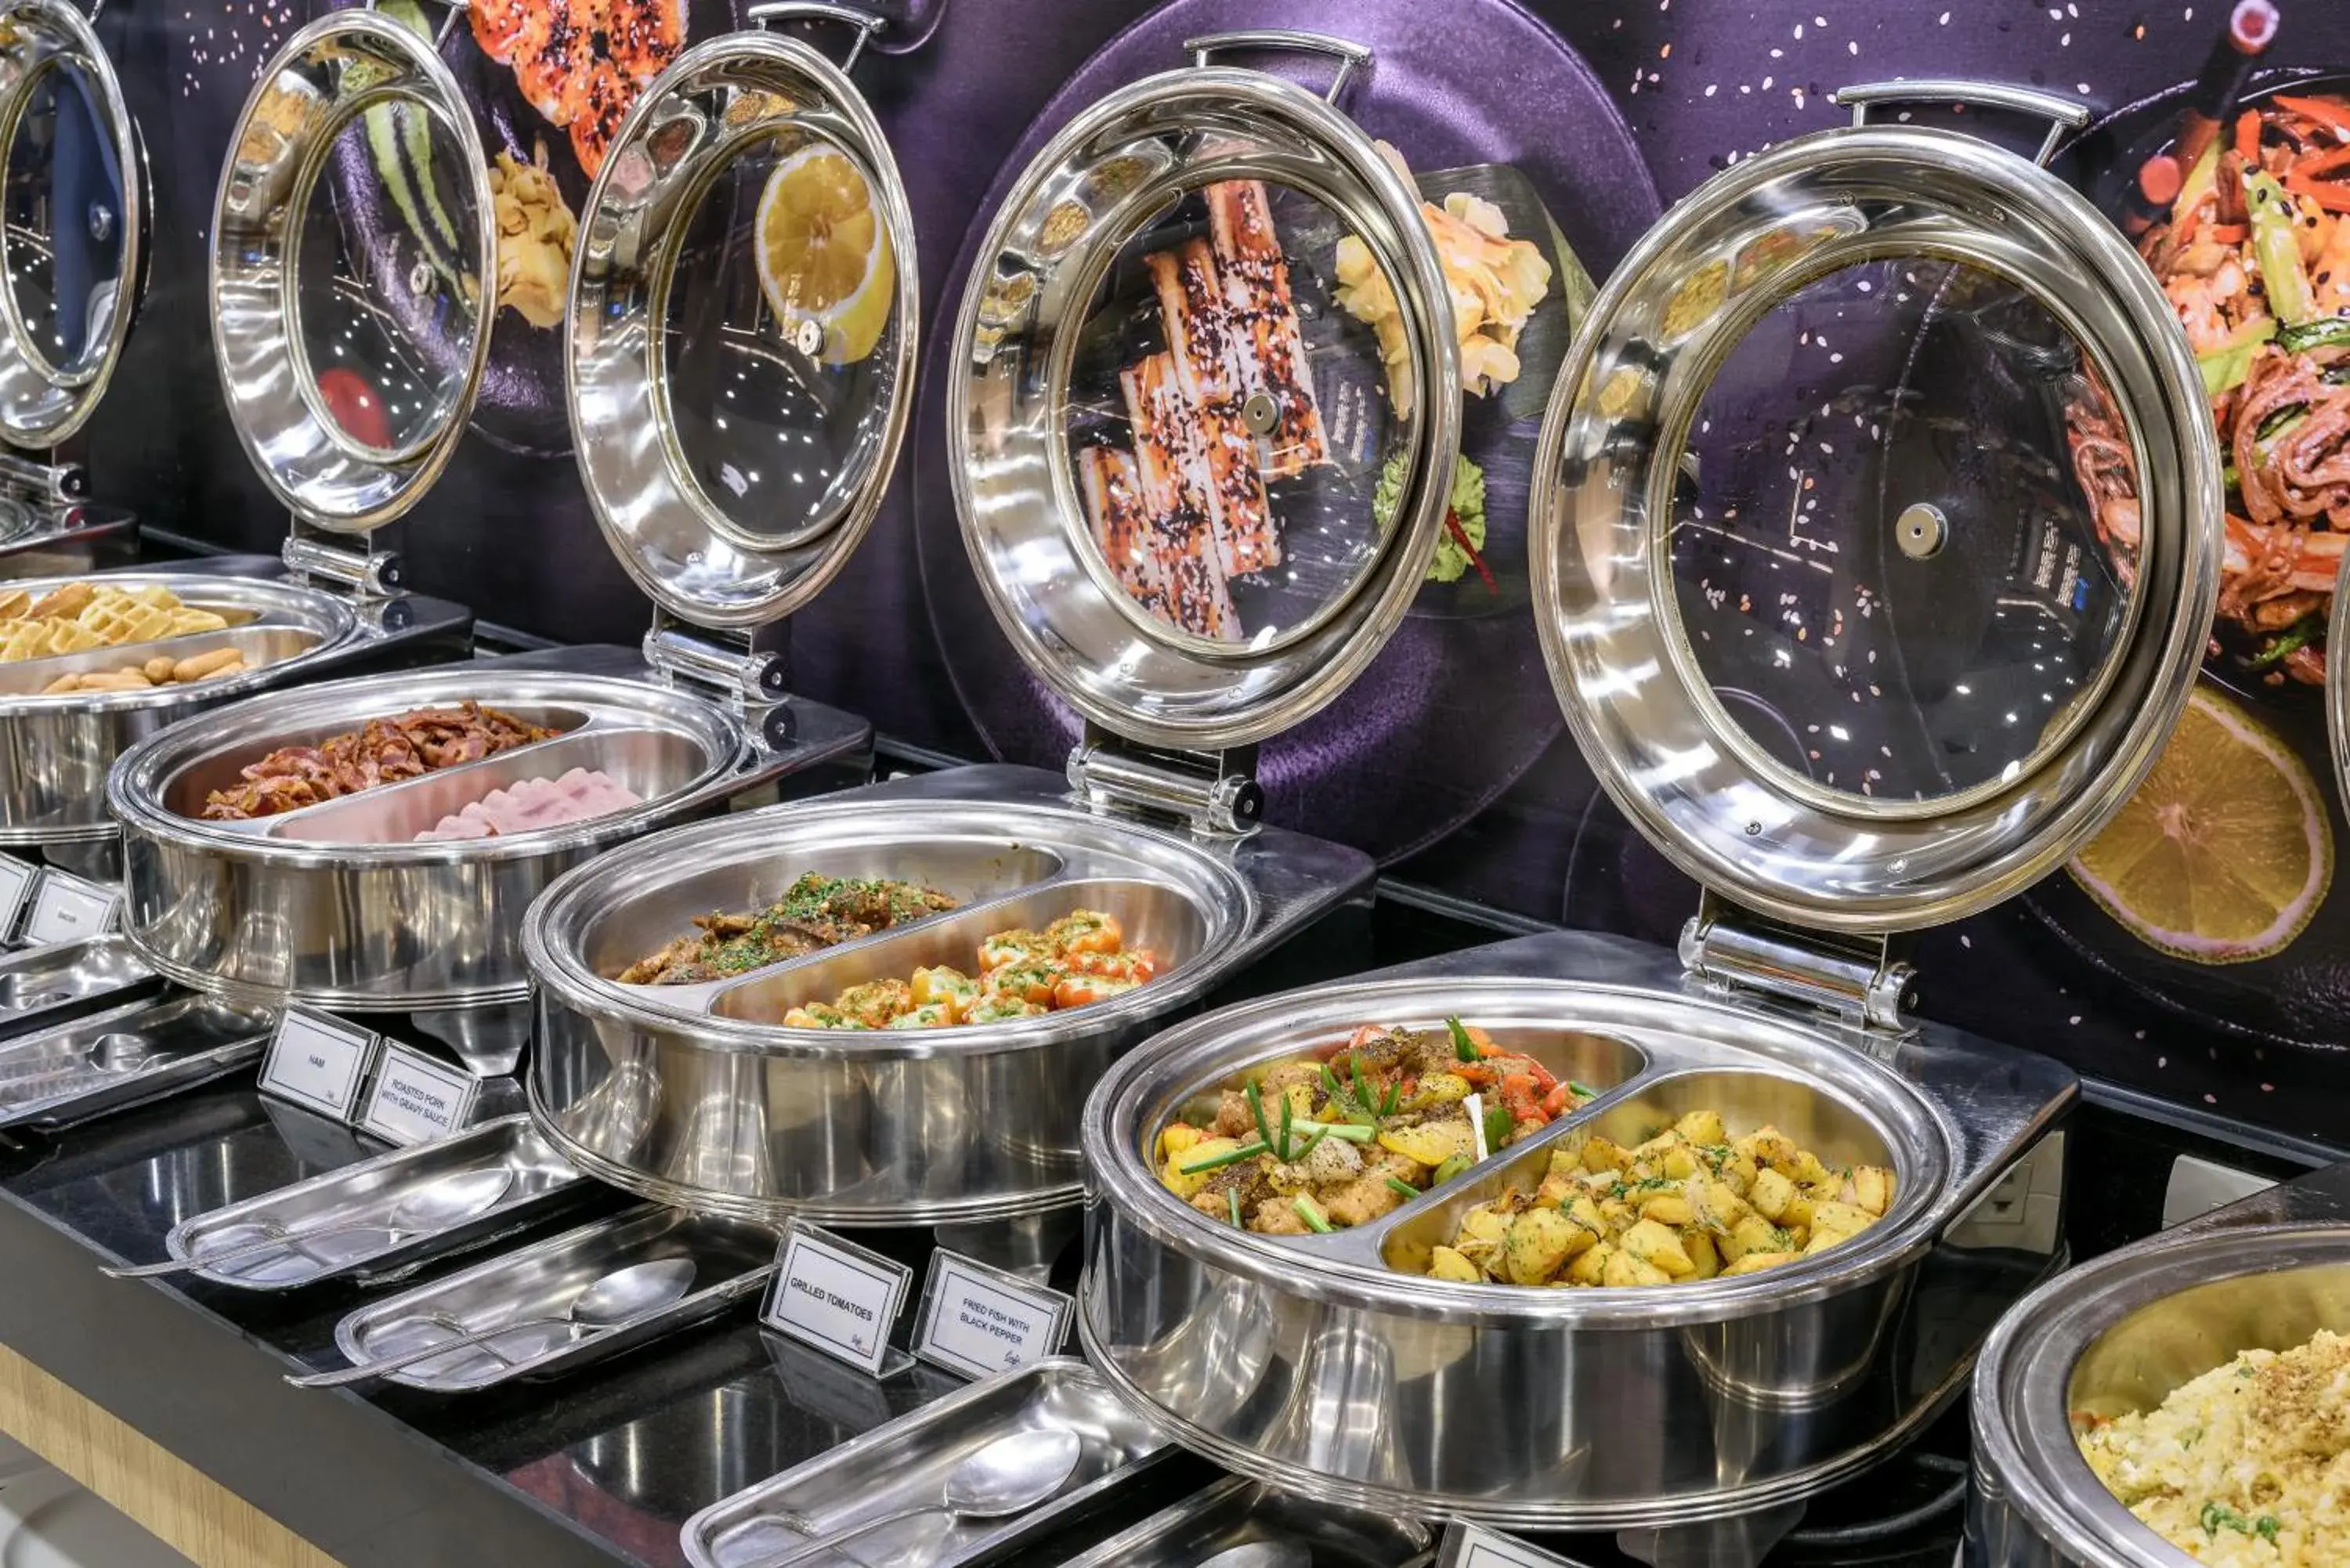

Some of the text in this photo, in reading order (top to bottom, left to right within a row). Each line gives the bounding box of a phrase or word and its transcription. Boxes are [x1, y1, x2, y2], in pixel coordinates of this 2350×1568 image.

[392, 1078, 425, 1100] ROASTED
[423, 1108, 450, 1127] SAUCE
[790, 1277, 873, 1321] GRILLED TOMATOES
[963, 1298, 1030, 1333] FRIED FISH WITH
[960, 1312, 1023, 1345] BLACK PEPPER
